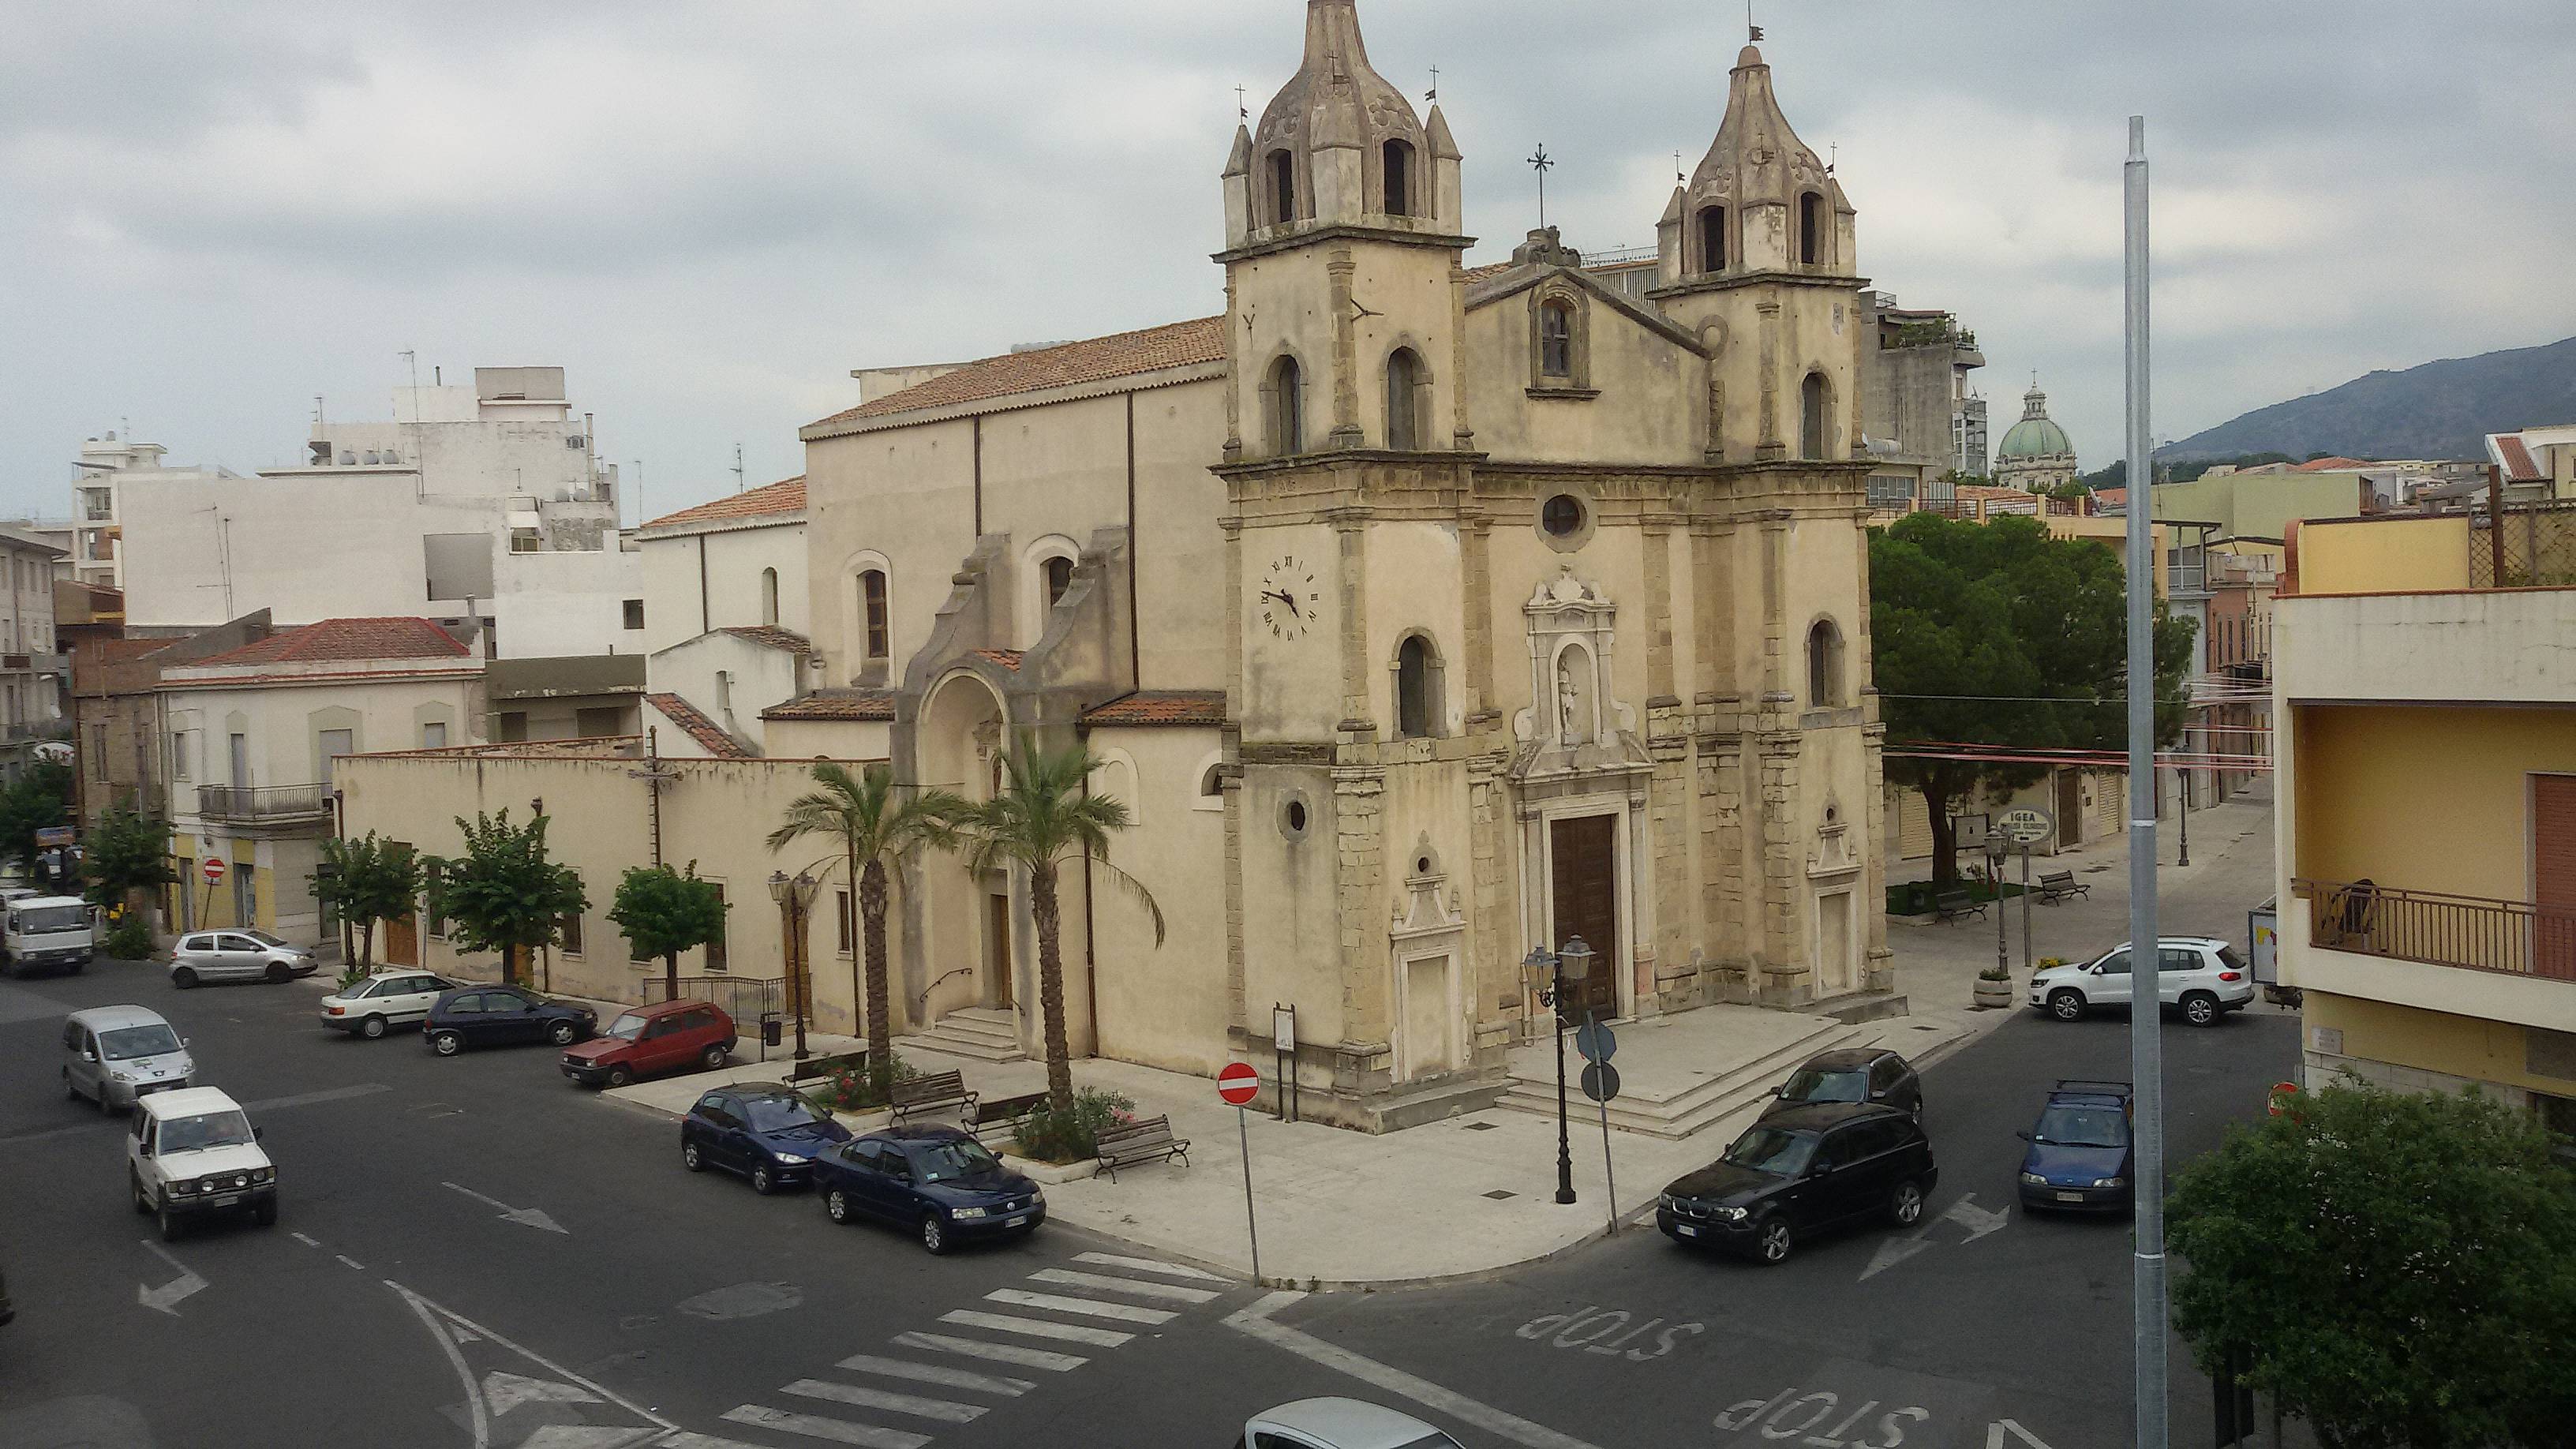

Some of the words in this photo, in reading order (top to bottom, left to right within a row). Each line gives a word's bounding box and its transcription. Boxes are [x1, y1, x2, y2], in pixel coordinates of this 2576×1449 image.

[1271, 561, 1280, 574] XI
[1263, 577, 1271, 586] X
[1306, 574, 1314, 582] II
[1264, 612, 1272, 627] VIII
[1308, 610, 1316, 622] IV
[1301, 625, 1307, 637] V
[2010, 812, 2035, 822] IGEA
[1515, 1305, 1705, 1361] STOP
[1713, 1387, 1930, 1449] STOP
